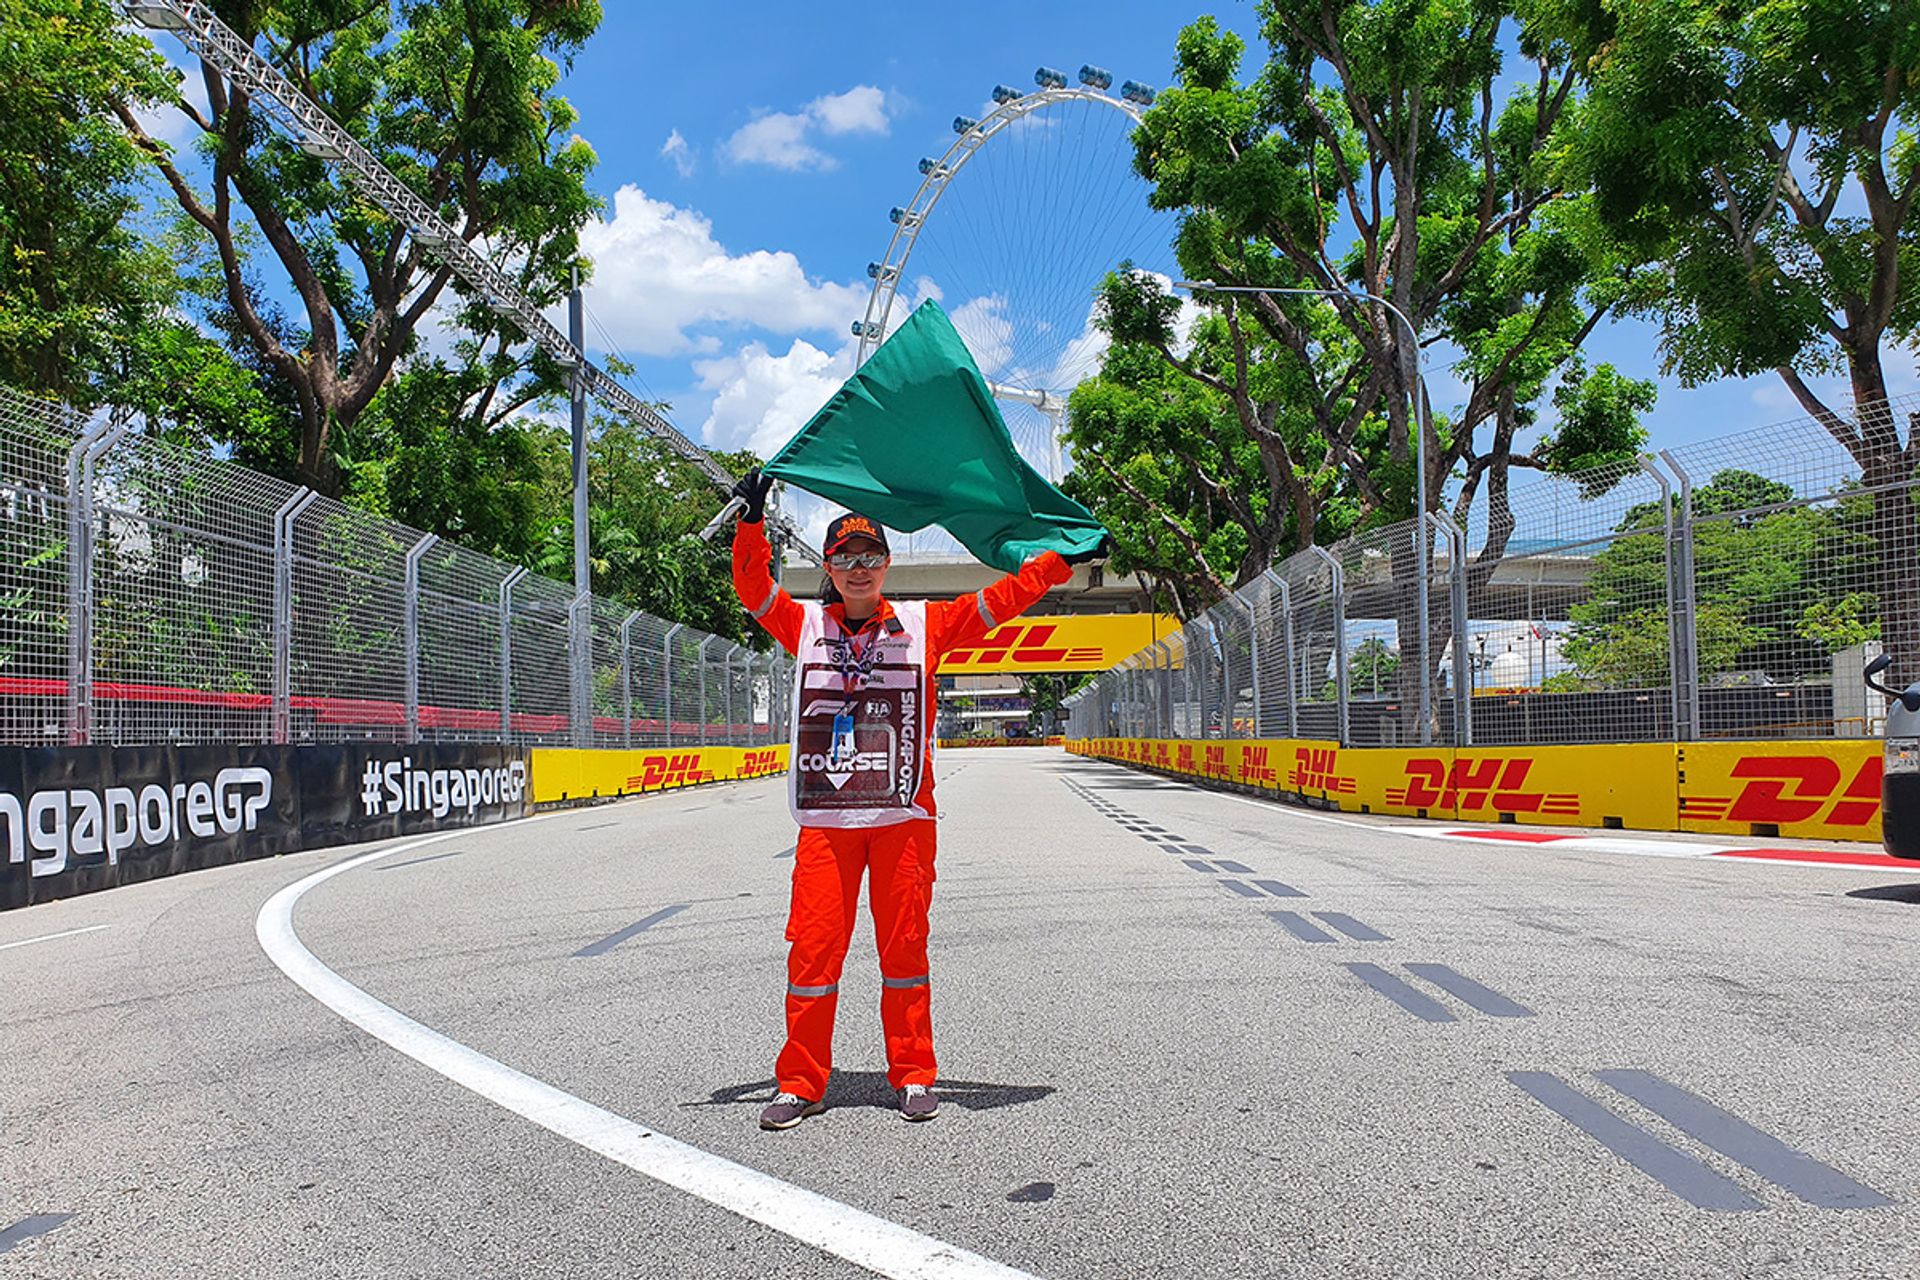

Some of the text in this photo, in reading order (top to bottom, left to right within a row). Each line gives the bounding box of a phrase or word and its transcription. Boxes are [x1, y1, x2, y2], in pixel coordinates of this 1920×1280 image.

[865, 701, 889, 715] FIA
[642, 755, 703, 785] DHL
[743, 751, 779, 775] DHL
[1243, 746, 1271, 780] DHL
[1295, 748, 1340, 790] DHL
[361, 756, 526, 818] #SingaporeGP
[1402, 759, 1544, 812] DHL
